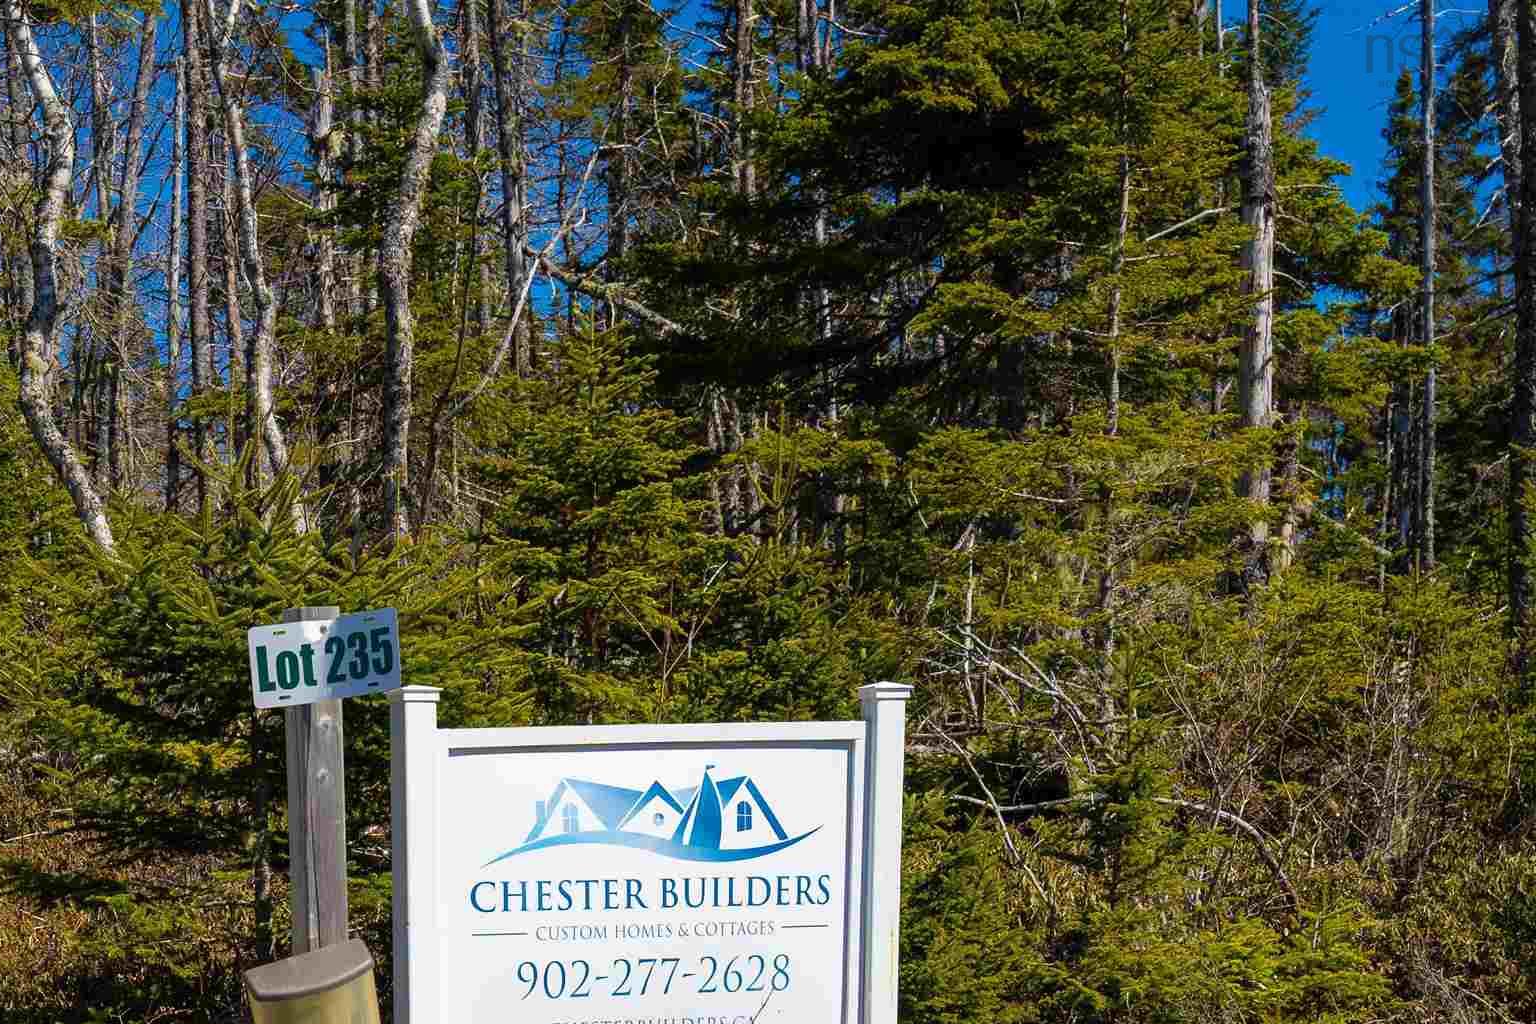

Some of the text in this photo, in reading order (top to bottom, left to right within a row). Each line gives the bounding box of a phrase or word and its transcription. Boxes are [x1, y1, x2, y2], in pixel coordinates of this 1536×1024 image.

[255, 626, 393, 692] Lot 235
[470, 873, 832, 914] CHESTER BUILDERS
[535, 920, 775, 942] CUSTOM HOMES & COTTAGES
[516, 954, 792, 1001] 902-277-2628
